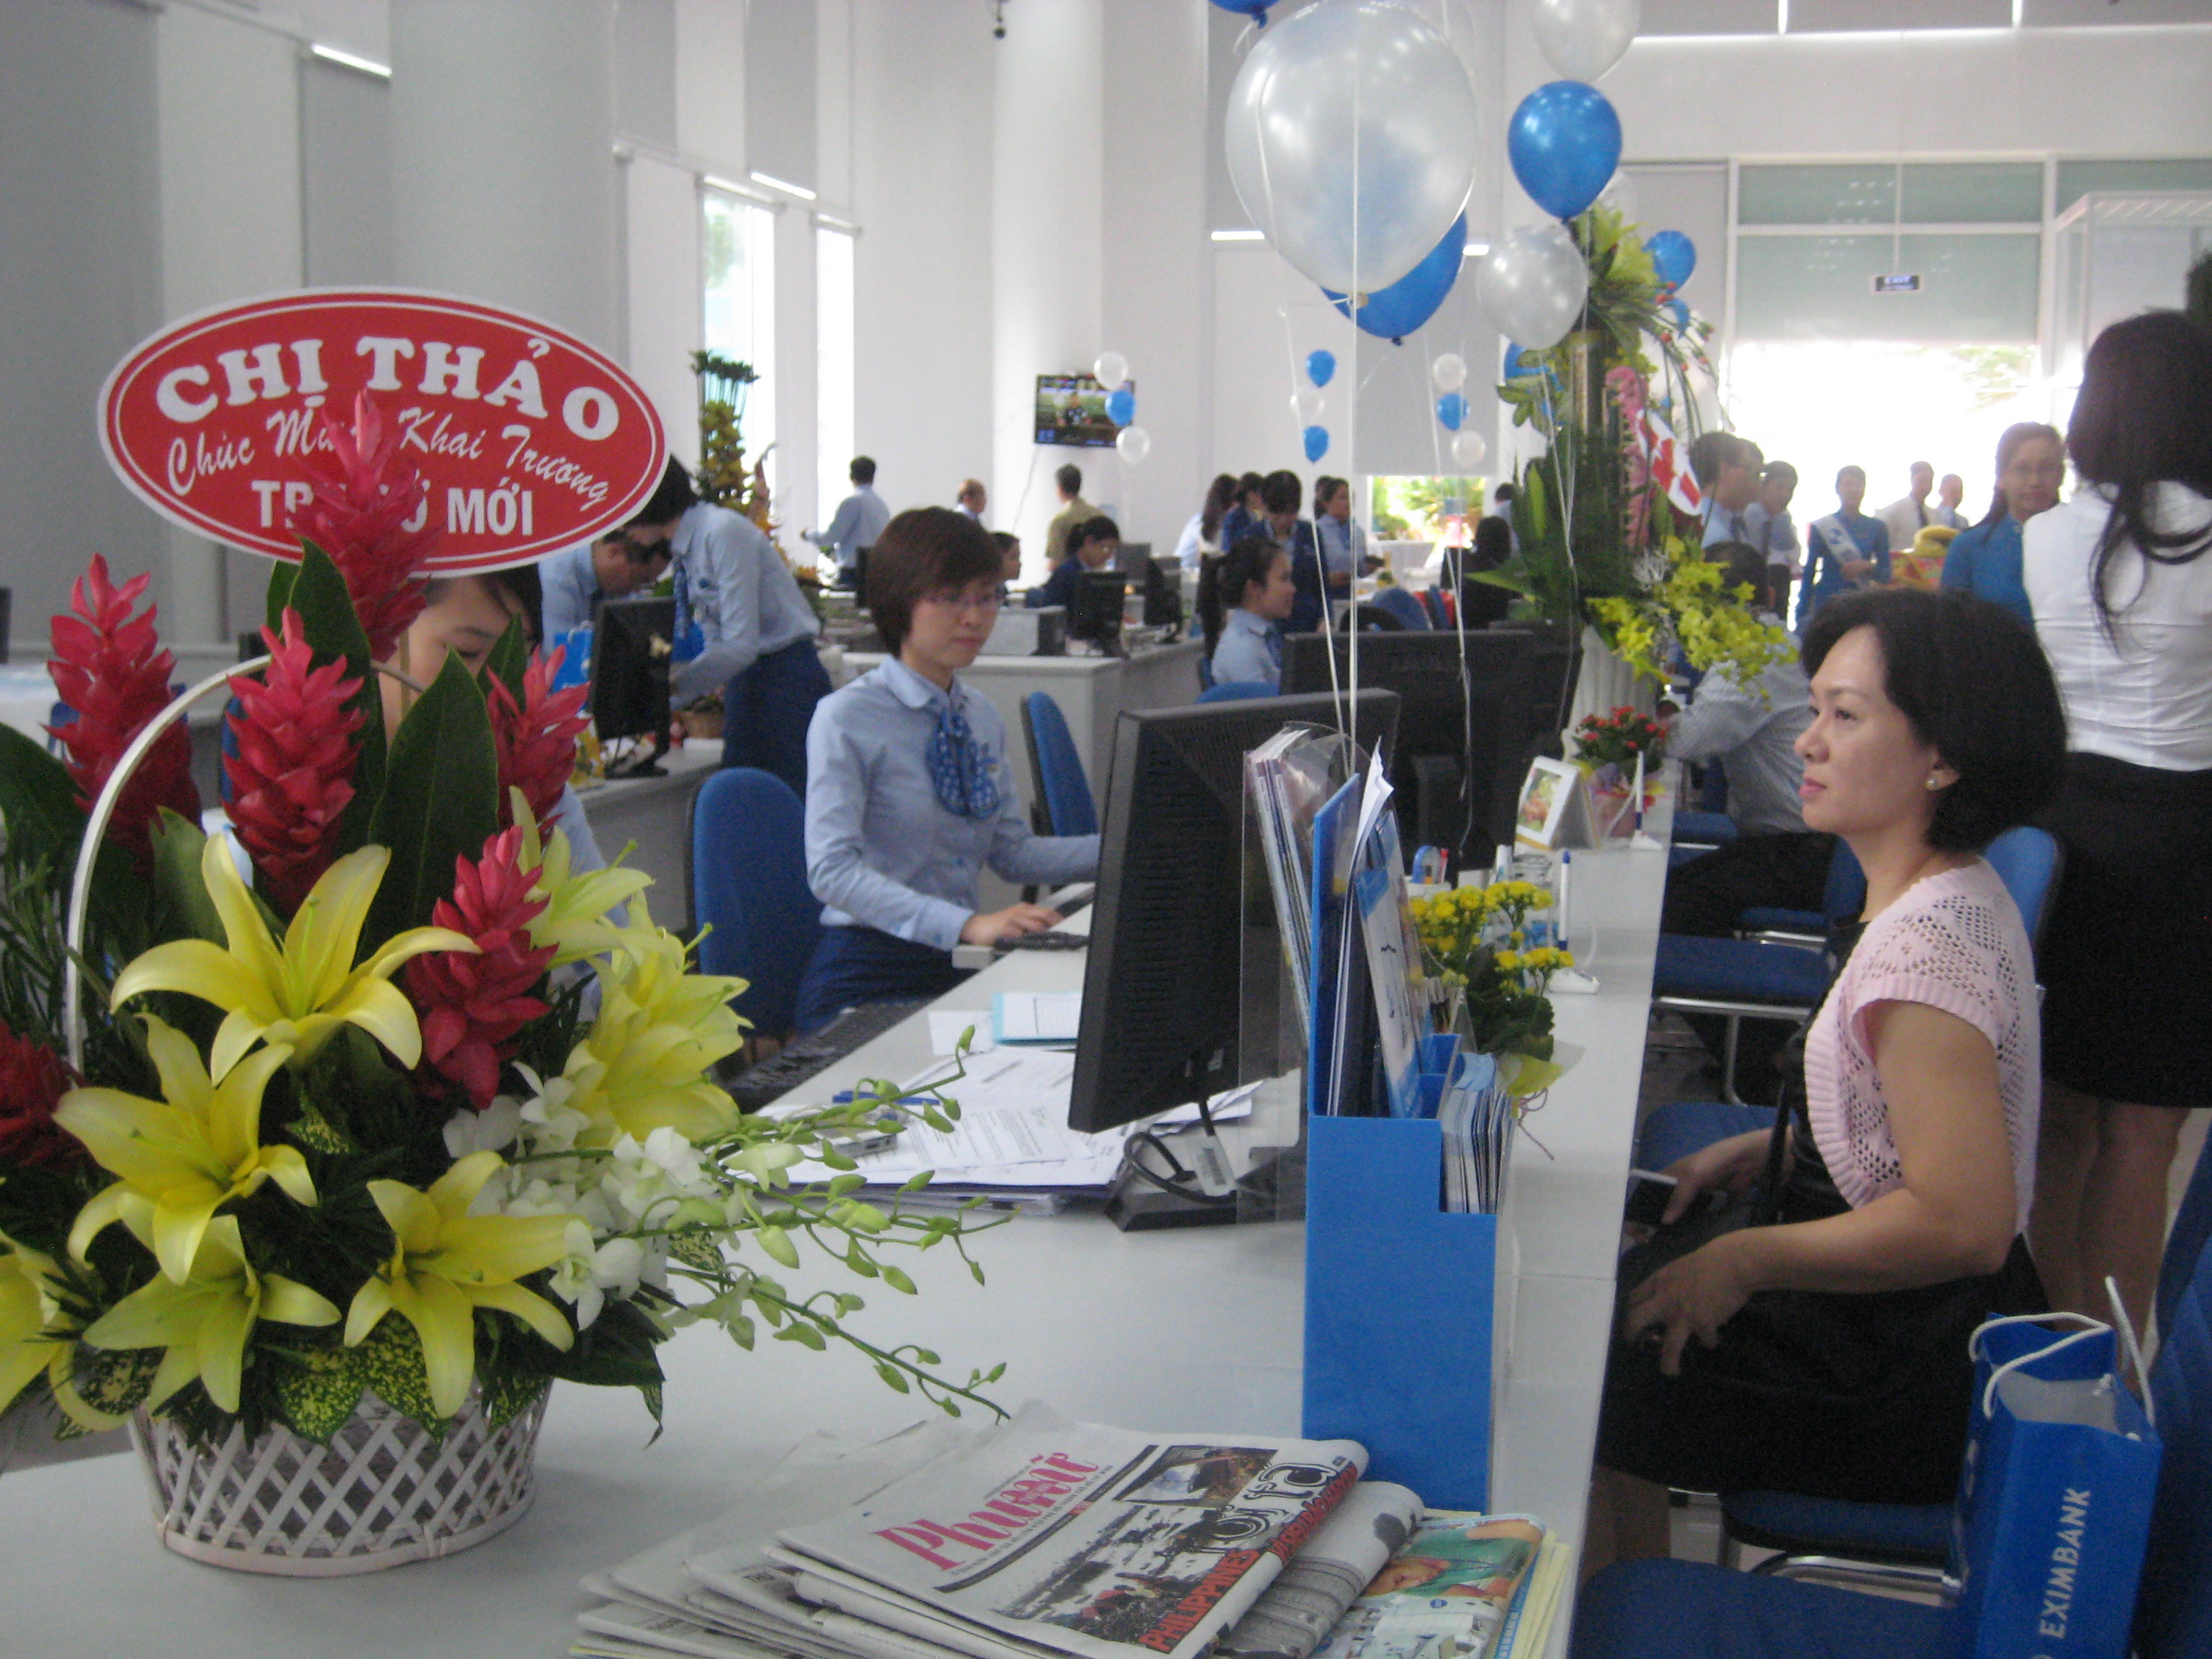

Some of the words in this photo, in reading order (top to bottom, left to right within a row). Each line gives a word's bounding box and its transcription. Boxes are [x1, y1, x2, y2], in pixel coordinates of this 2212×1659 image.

[356, 337, 620, 441] THẢO
[168, 432, 255, 497] Chúc
[398, 406, 487, 460] Khai
[447, 476, 534, 536] MỚI
[1138, 1548, 1262, 1652] PHILIPPINES
[2038, 1487, 2091, 1639] EXIMBANK
